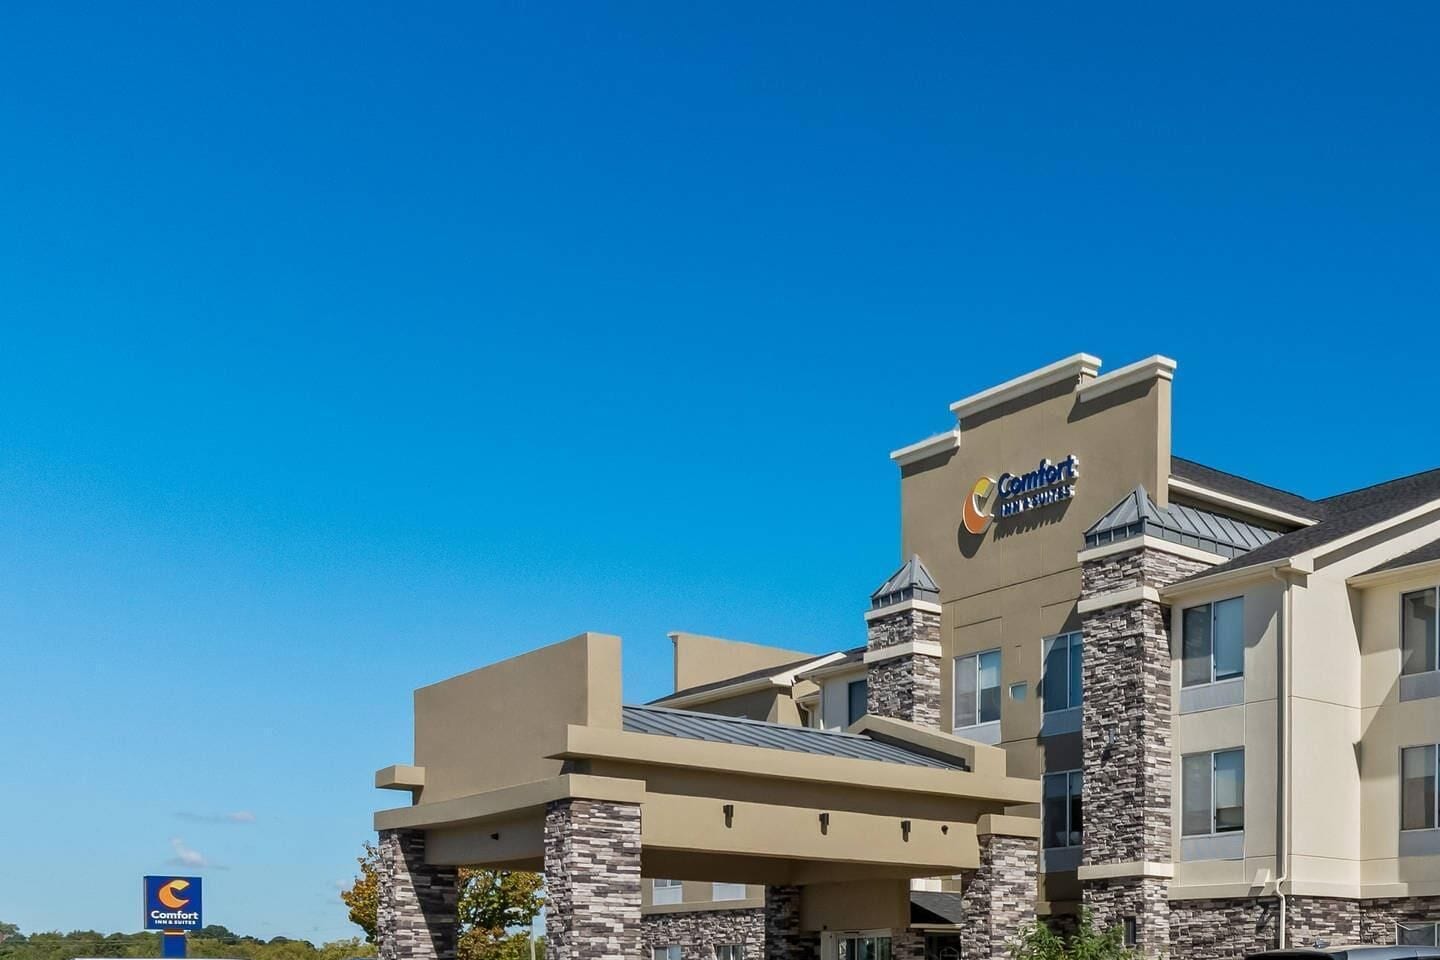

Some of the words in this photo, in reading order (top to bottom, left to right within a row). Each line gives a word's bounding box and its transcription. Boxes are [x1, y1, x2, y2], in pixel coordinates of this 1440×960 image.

[998, 454, 1078, 497] Comfort
[1001, 499, 1024, 517] INN
[1032, 484, 1075, 507] SUITES
[151, 910, 199, 919] Comfort
